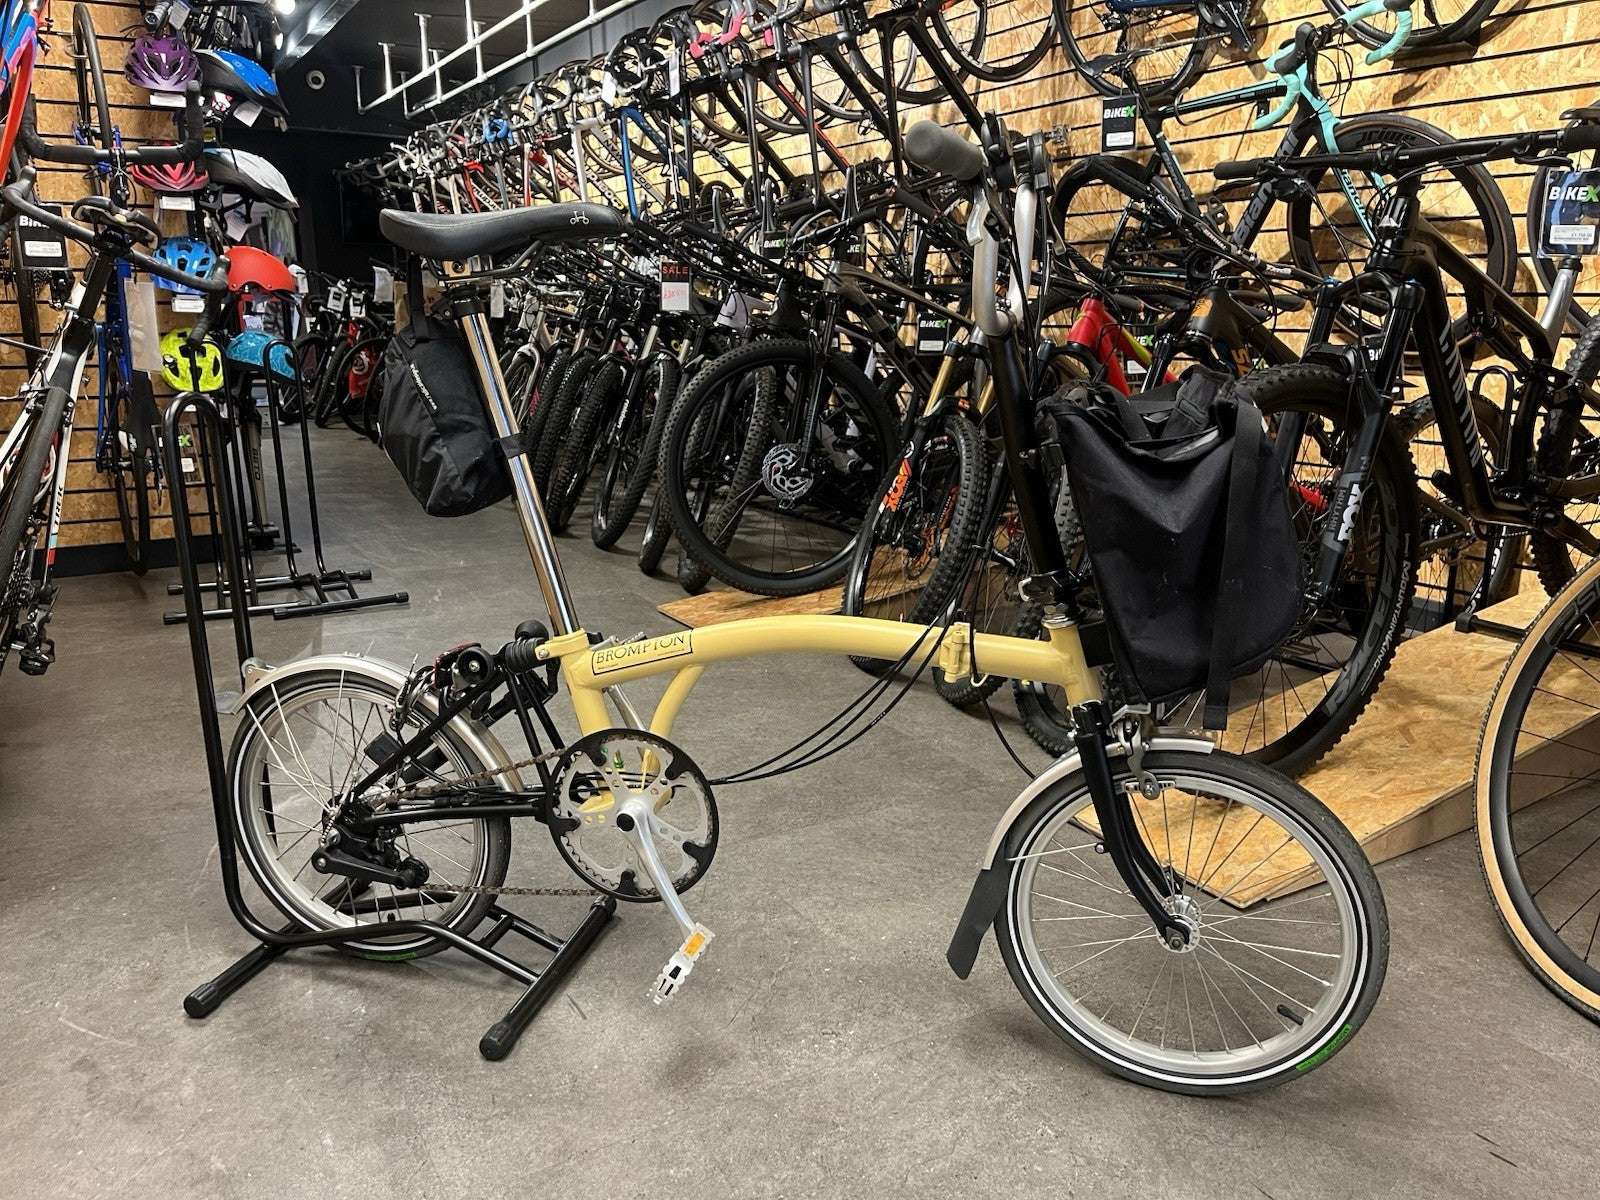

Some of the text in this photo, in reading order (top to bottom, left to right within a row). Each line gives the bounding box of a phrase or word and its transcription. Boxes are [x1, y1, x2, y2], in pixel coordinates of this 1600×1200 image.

[662, 266, 689, 274] SALE
[1328, 487, 1347, 531] RHYTHM
[1337, 483, 1362, 541] FOX
[595, 634, 685, 664] BROMPTON
